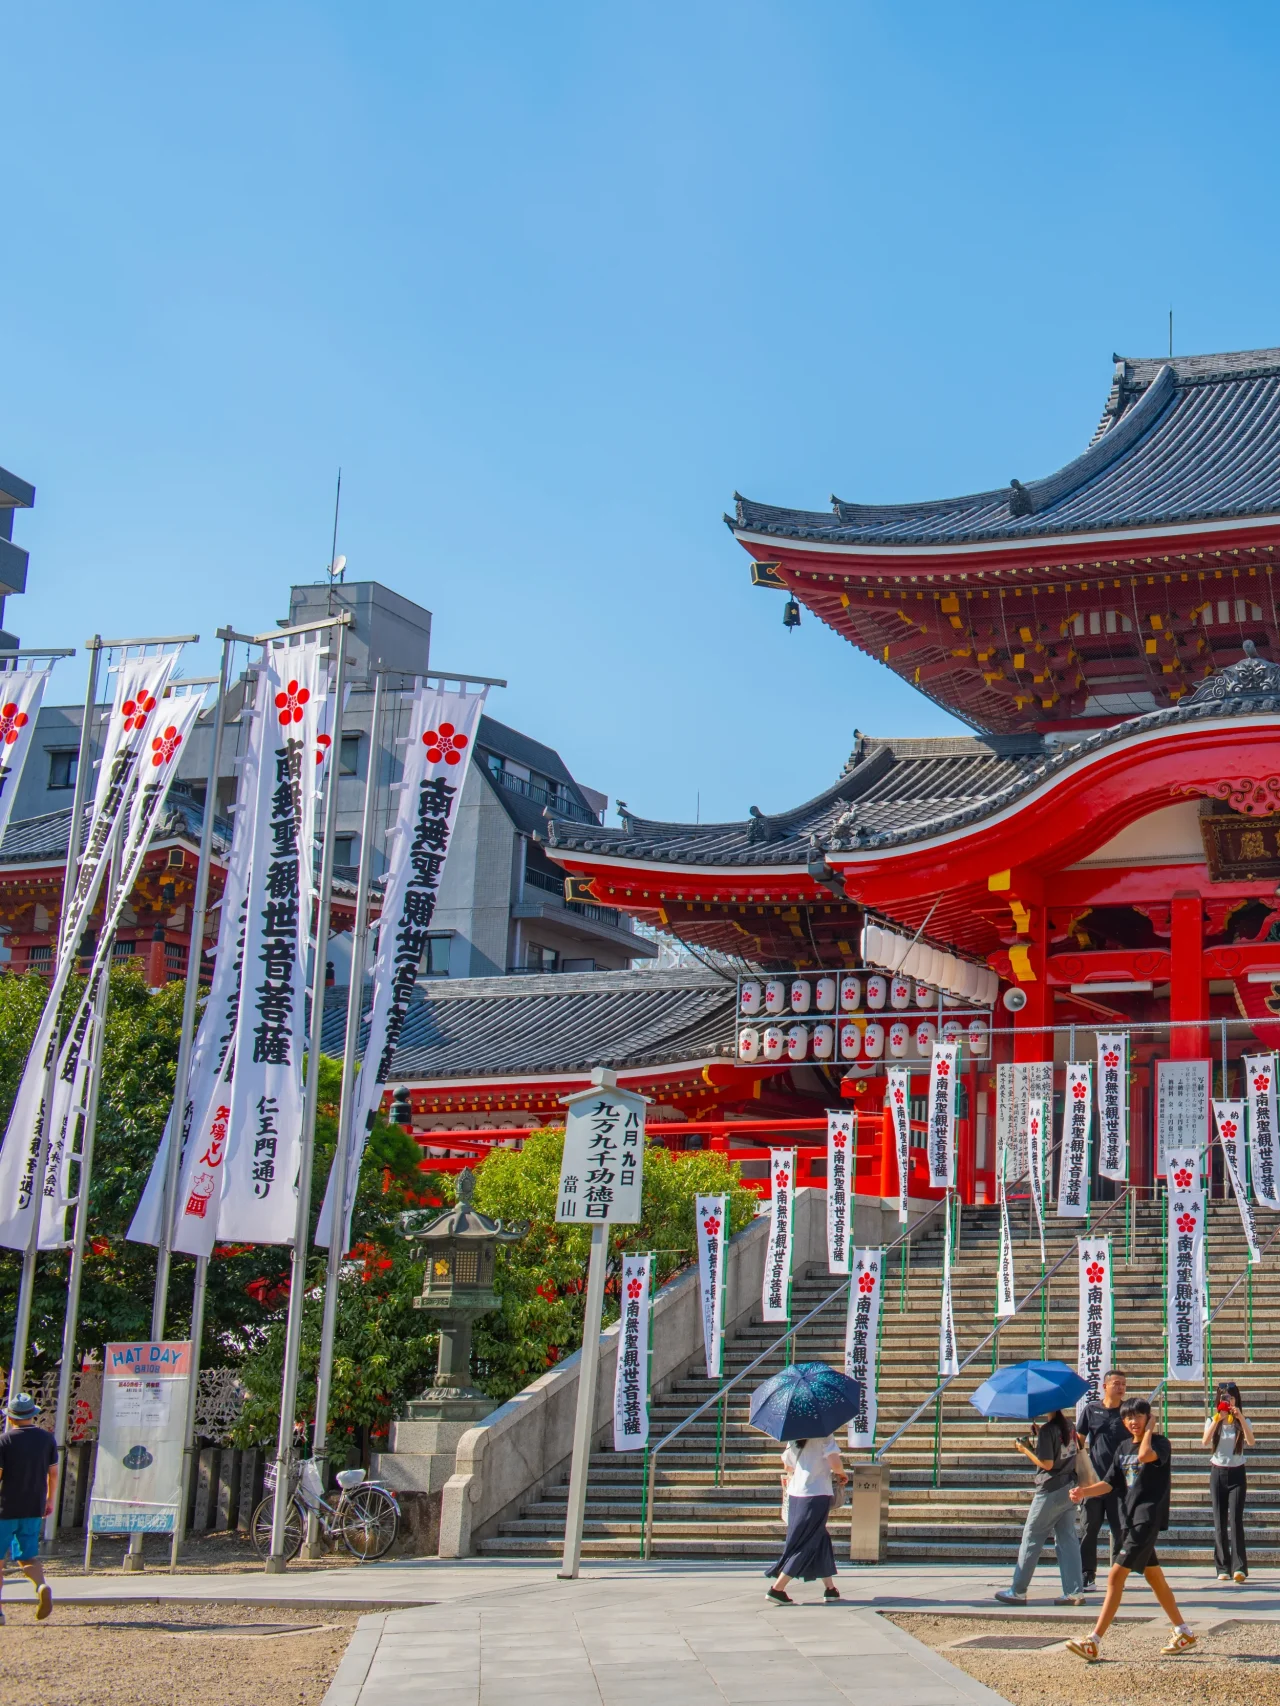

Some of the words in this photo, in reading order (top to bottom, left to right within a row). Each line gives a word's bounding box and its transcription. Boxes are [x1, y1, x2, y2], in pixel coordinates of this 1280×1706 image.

[252, 737, 304, 1067] 南無聖観世音菩薩
[935, 1051, 953, 1061] 奉納
[1100, 1043, 1121, 1052] 奉納
[1069, 1073, 1088, 1082] 奉納
[1249, 1065, 1271, 1074] 奉納
[1105, 1068, 1119, 1169] 南無聖観世音菩薩
[1197, 1077, 1205, 1120] 写経のすすめ
[1217, 1111, 1239, 1120] 奉納
[199, 1105, 231, 1168] 矢場とん
[830, 1121, 850, 1131] 奉納
[935, 1076, 949, 1177] 南無聖観世音菩薩
[1256, 1092, 1277, 1201] 南無聖観世音菩薩
[252, 1096, 279, 1200] 仁王門通り
[583, 1101, 620, 1218] 九万九千功徳日
[620, 1112, 639, 1186] 八月九日
[773, 1159, 791, 1169] 奉納
[1065, 1100, 1086, 1206] 南無聖観世音菩薩
[1170, 1158, 1195, 1169] 奉納
[561, 1175, 579, 1217] 當山
[699, 1206, 723, 1216] 奉納
[833, 1149, 846, 1262] 南無聖観世音菩薩
[768, 1189, 788, 1309] 南無聖観世音菩薩
[856, 1260, 878, 1272] 奉納
[1082, 1250, 1106, 1262] 奉納
[625, 1266, 646, 1277] 奉納
[112, 1346, 143, 1367] HAT
[150, 1346, 182, 1365] DAY
[1086, 1285, 1103, 1404] 南無聖観世音菩
[623, 1299, 642, 1436] 南無聖観世音菩薩
